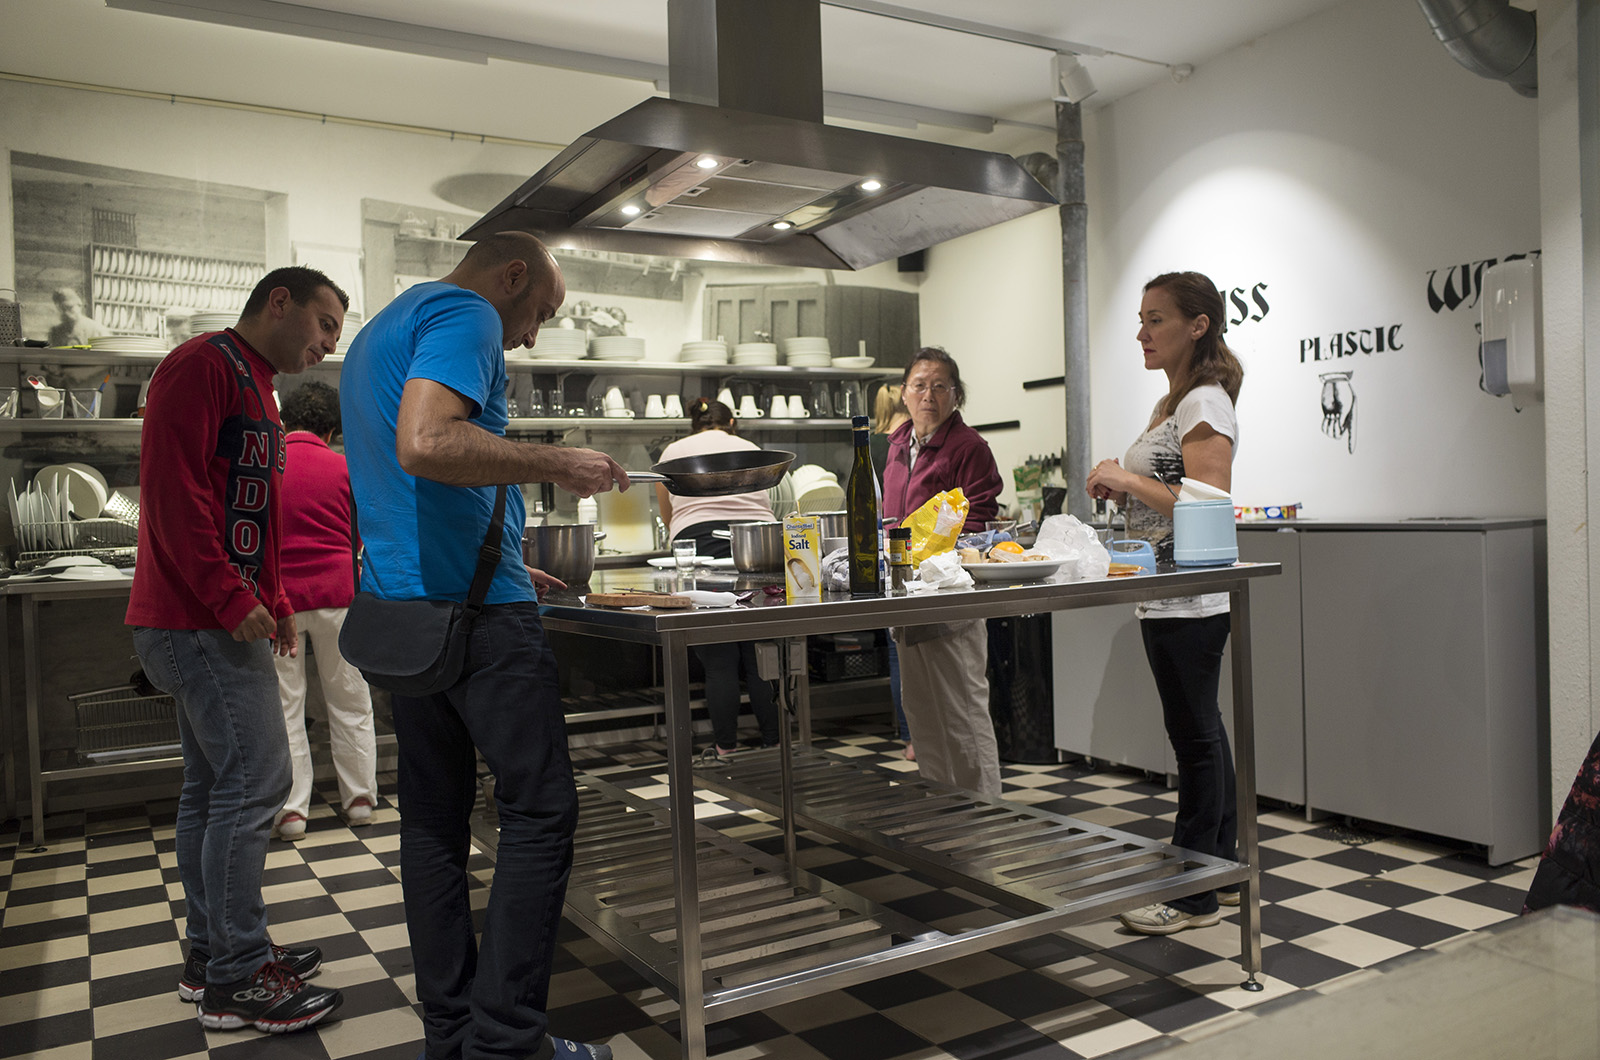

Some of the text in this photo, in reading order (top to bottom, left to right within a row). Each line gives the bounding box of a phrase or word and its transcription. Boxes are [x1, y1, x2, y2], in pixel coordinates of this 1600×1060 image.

[1219, 282, 1269, 334] SS
[1300, 323, 1404, 363] PLASTIC
[789, 539, 810, 550] Salt
